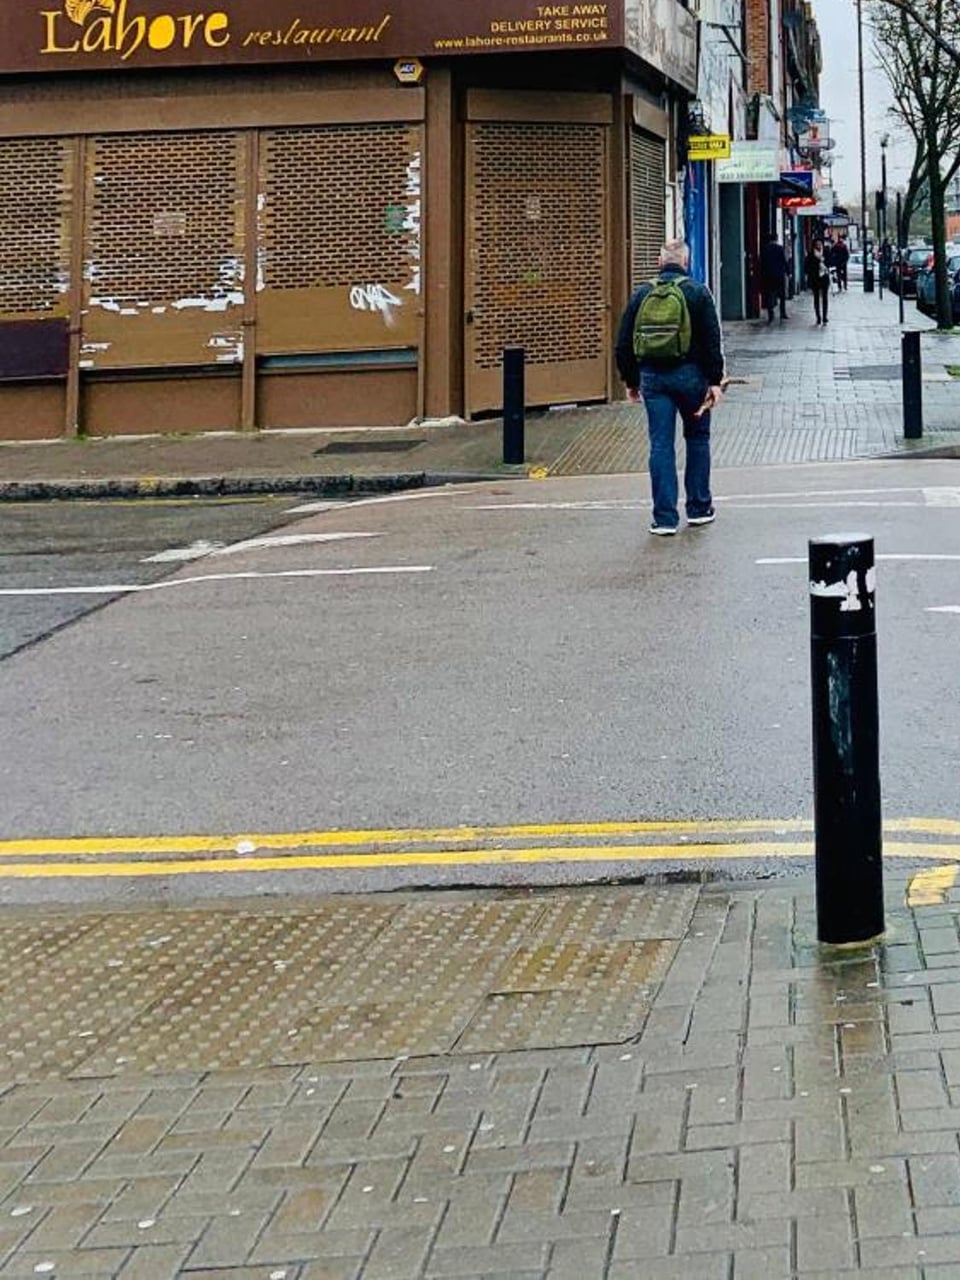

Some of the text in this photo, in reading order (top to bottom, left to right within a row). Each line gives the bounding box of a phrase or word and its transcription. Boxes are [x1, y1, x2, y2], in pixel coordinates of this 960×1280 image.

[536, 4, 608, 17] TAKE AWAY
[242, 14, 391, 49] restaurant
[490, 17, 608, 33] DELIVERY SERVICE
